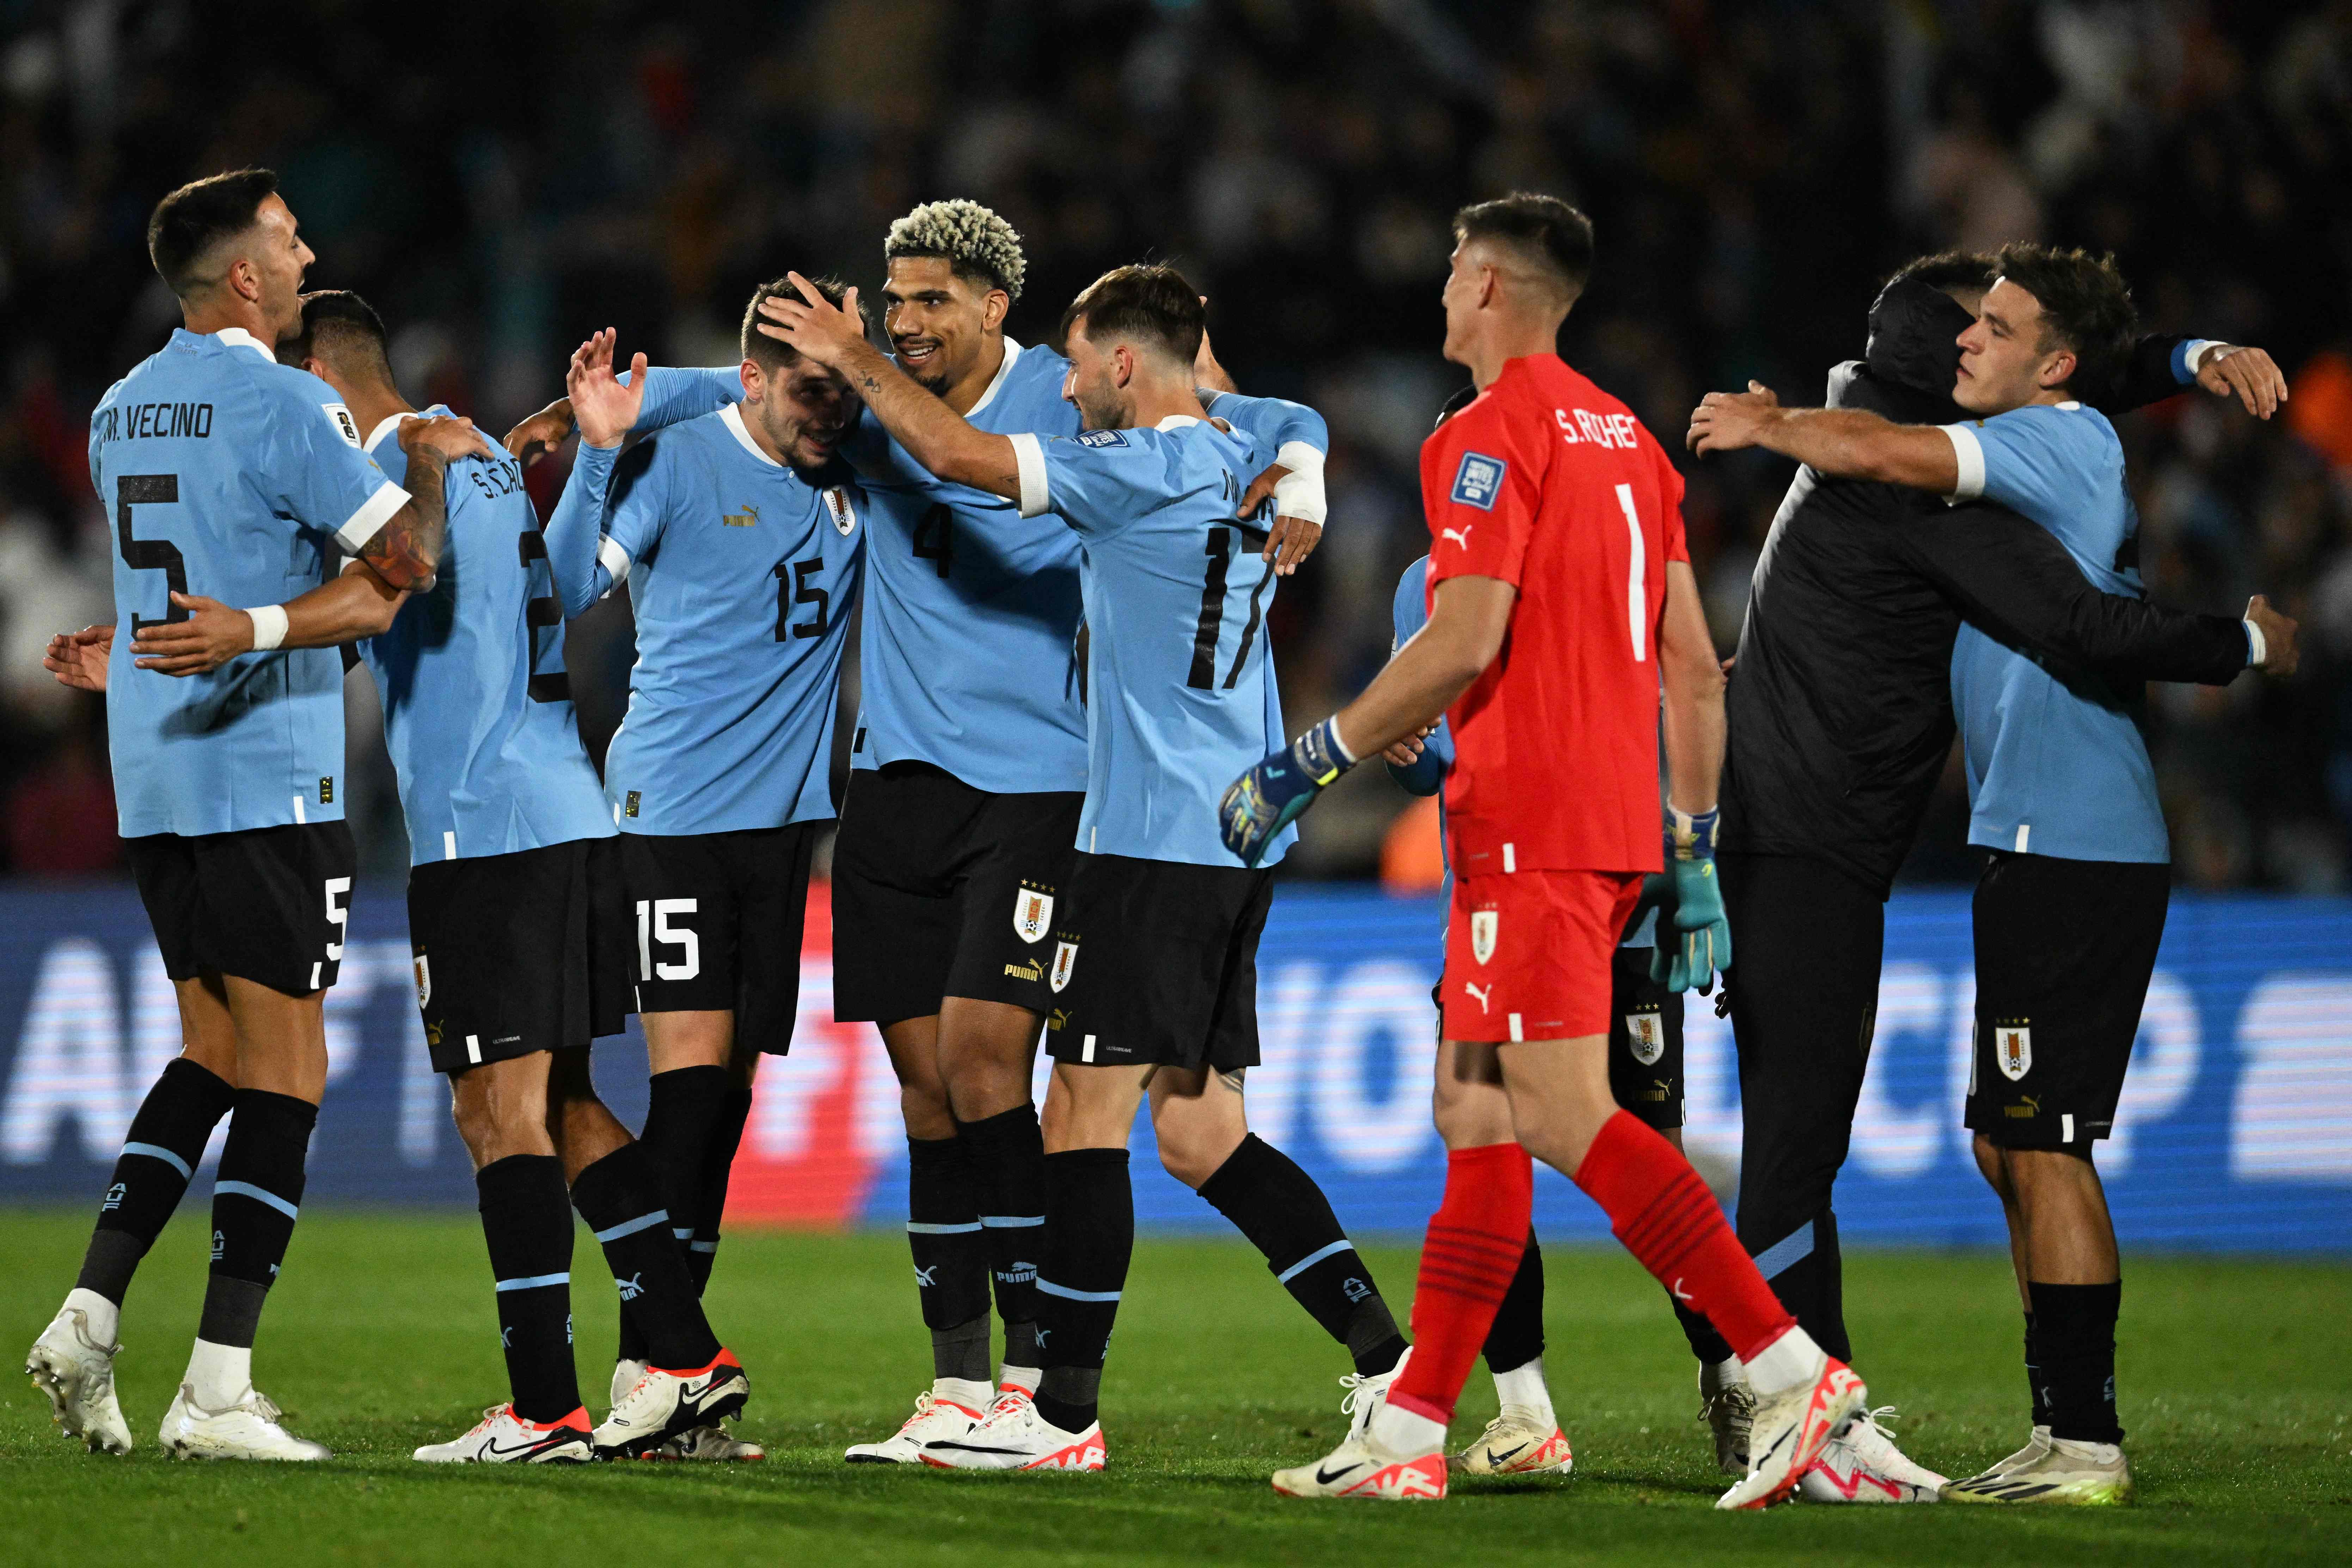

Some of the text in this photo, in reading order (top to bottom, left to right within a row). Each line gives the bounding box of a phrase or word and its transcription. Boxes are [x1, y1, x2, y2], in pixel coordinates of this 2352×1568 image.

[127, 403, 213, 440] VECINO
[117, 474, 190, 641] 5
[912, 502, 953, 578] 4
[1615, 483, 1645, 661] 1
[775, 557, 828, 643] 15
[1187, 527, 1275, 690] 17
[325, 877, 350, 961] 5
[636, 898, 699, 981] 15
[1004, 964, 1038, 982] PUMA
[101, 1183, 126, 1212] AUF
[210, 1230, 225, 1263] AUF
[997, 1269, 1037, 1283] PUMA
